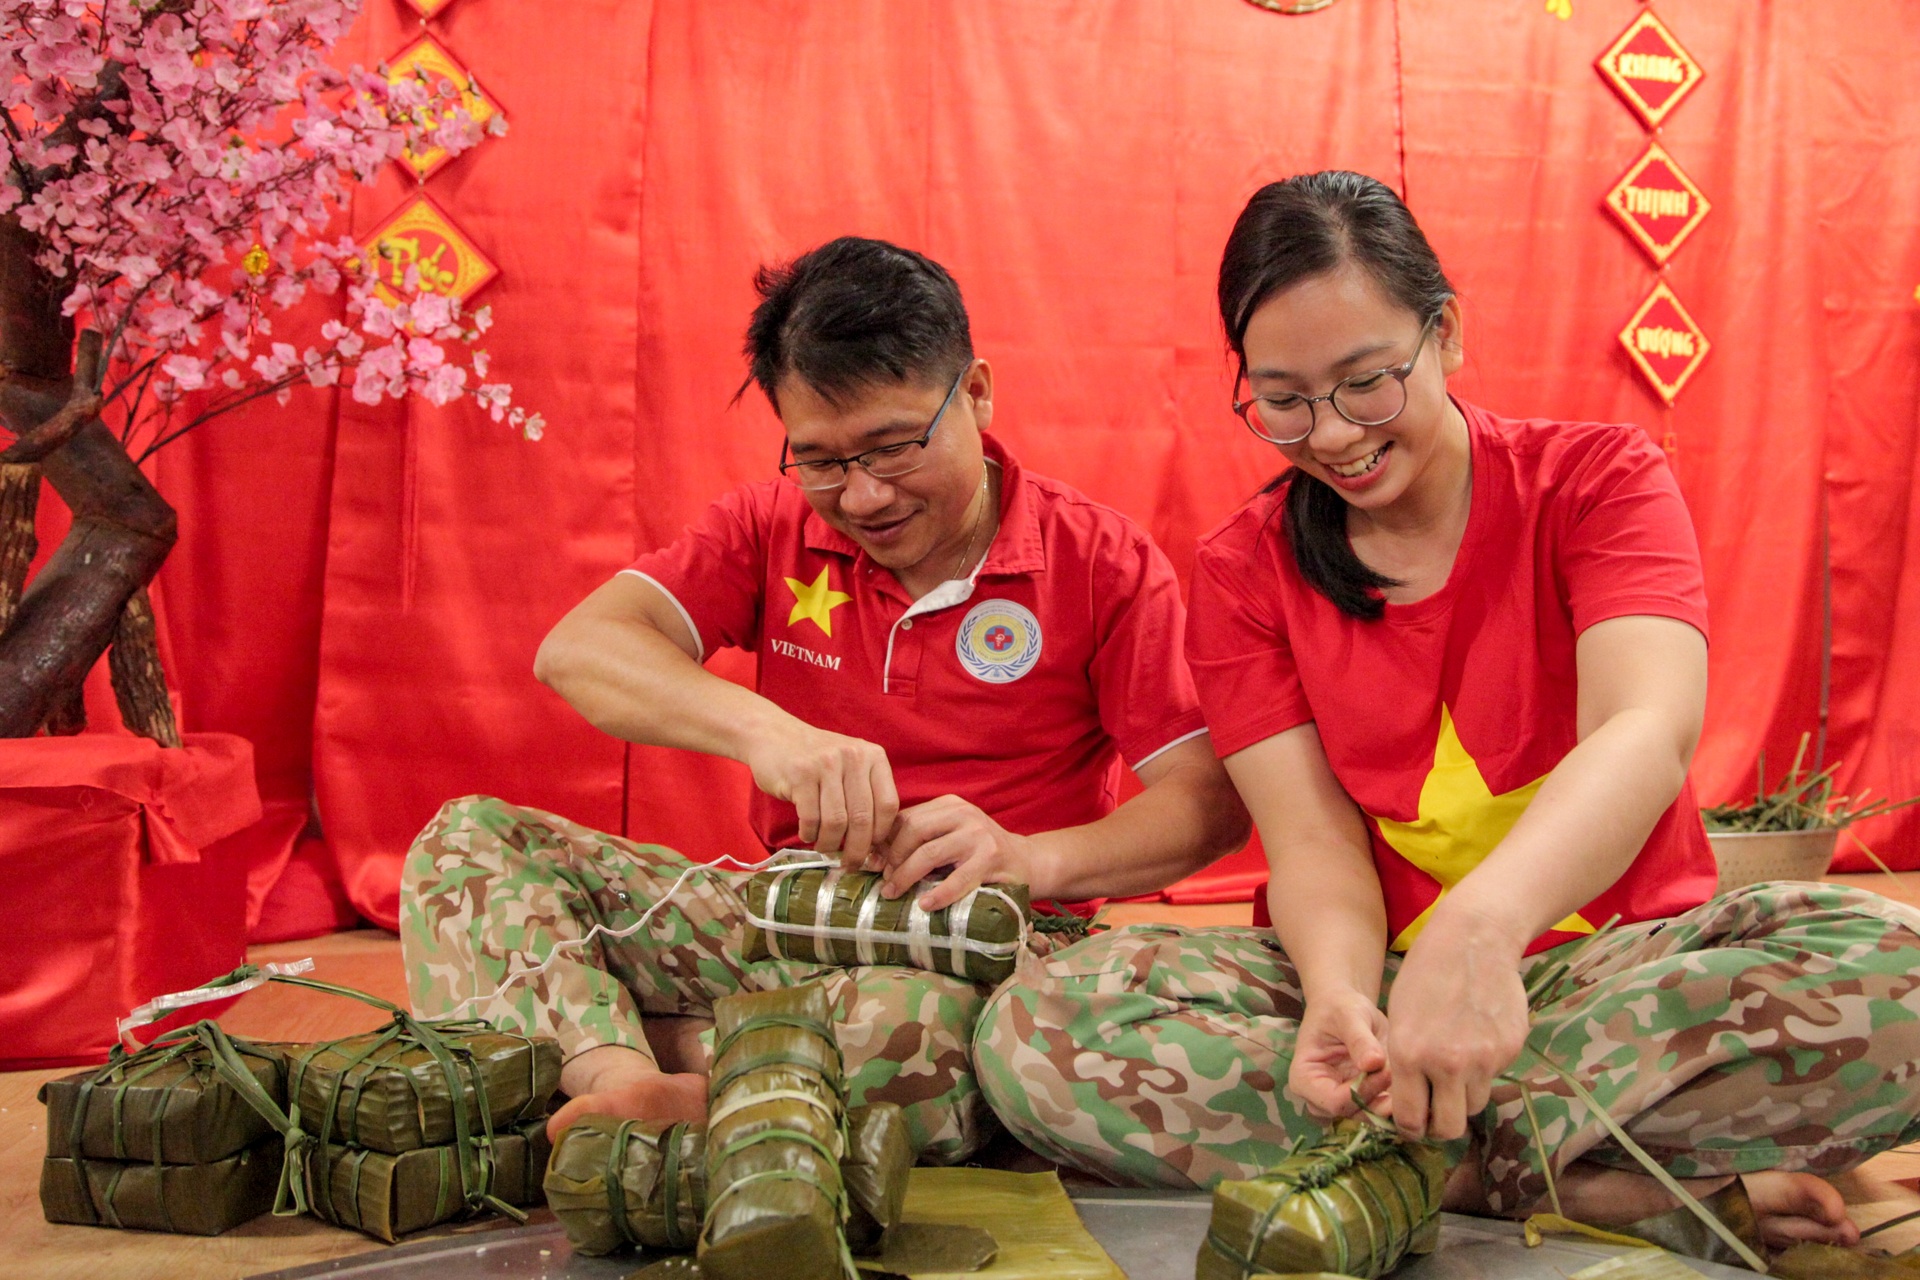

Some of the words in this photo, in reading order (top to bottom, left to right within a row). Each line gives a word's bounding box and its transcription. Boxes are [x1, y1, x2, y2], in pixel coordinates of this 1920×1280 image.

[1619, 52, 1684, 83] KHANG
[1624, 186, 1690, 220] THỊNH
[1636, 327, 1695, 359] VƯỢNG
[771, 638, 842, 671] VIETNAM
